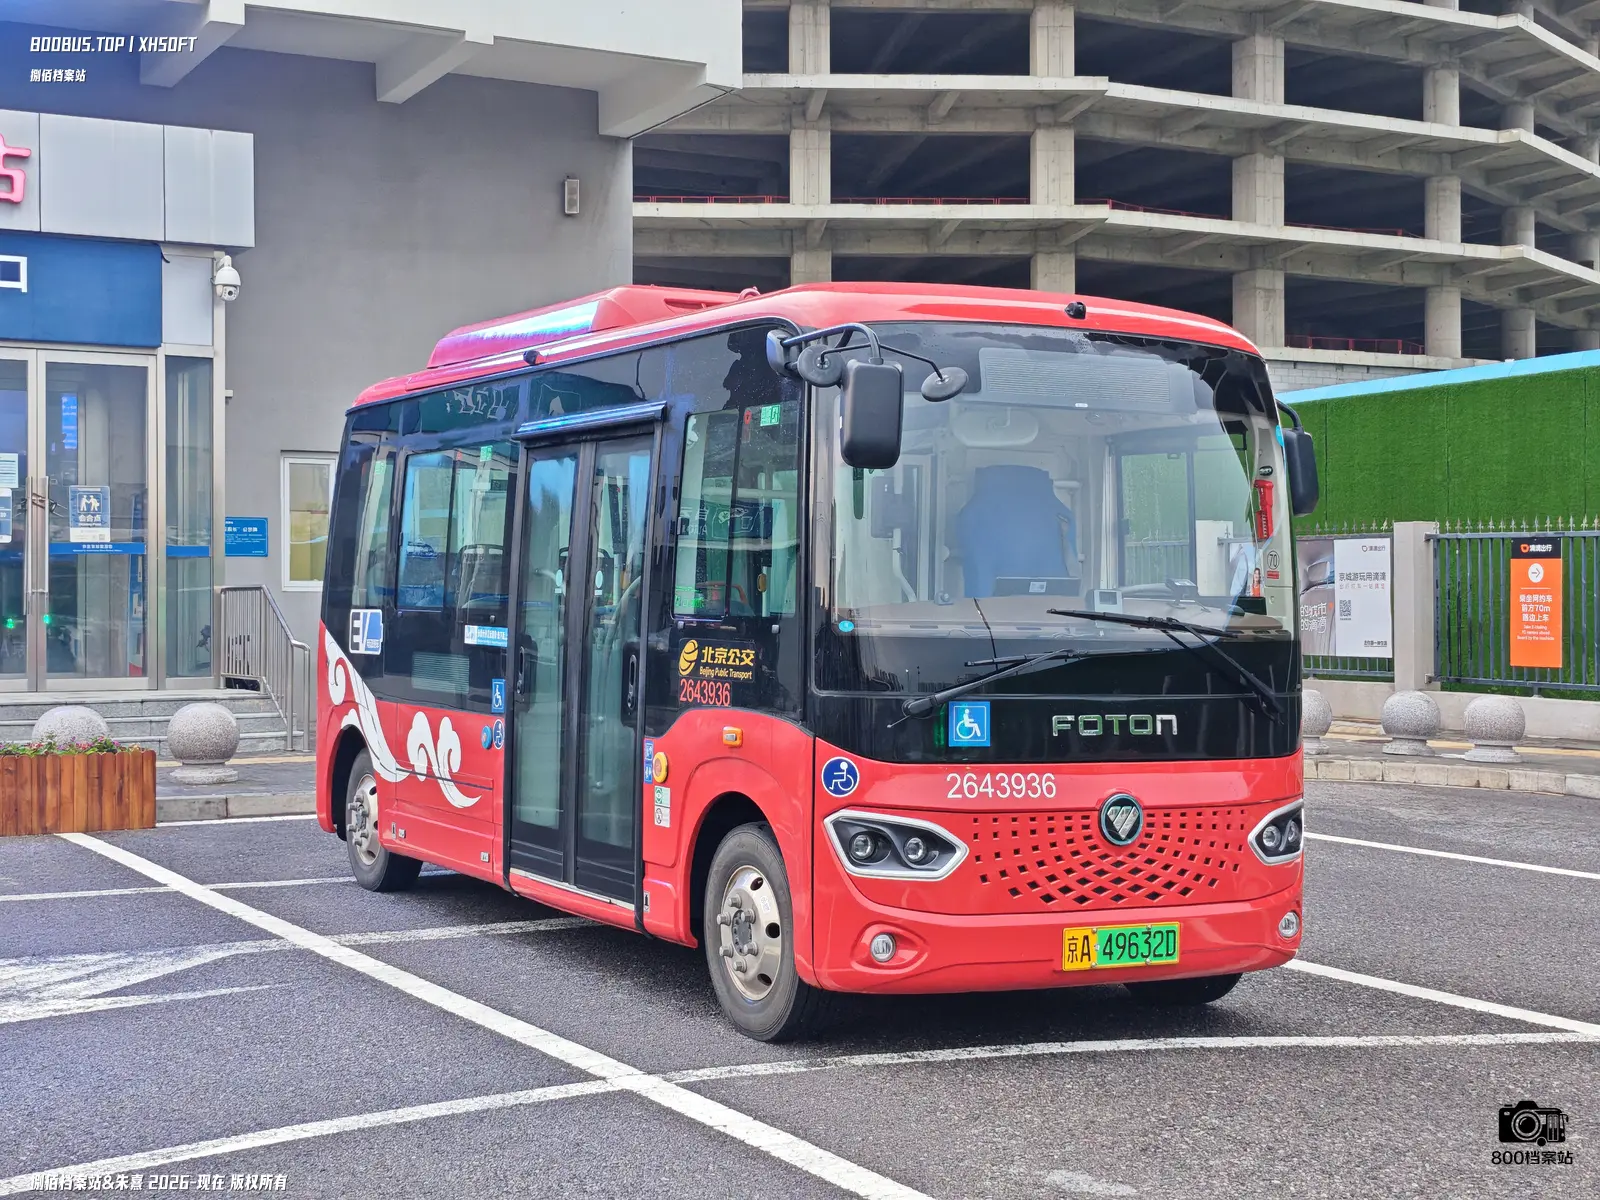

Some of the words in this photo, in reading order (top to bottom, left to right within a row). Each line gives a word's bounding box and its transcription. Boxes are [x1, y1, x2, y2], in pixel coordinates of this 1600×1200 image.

[1339, 572, 1387, 582] 京城游玩用滴滴
[1520, 594, 1552, 603] 乘坐网约车
[1521, 604, 1551, 613] 前方70m
[1522, 613, 1549, 622] 路边上车
[701, 646, 755, 667] 北京公交
[700, 666, 714, 678] Beijing
[715, 667, 729, 677] Public
[730, 668, 752, 680] Transport
[680, 678, 731, 707] 2643936
[1052, 714, 1178, 737] FOTON
[946, 772, 1056, 799] 2643936
[1067, 935, 1091, 963] 京A
[1102, 930, 1176, 961] 49632D
